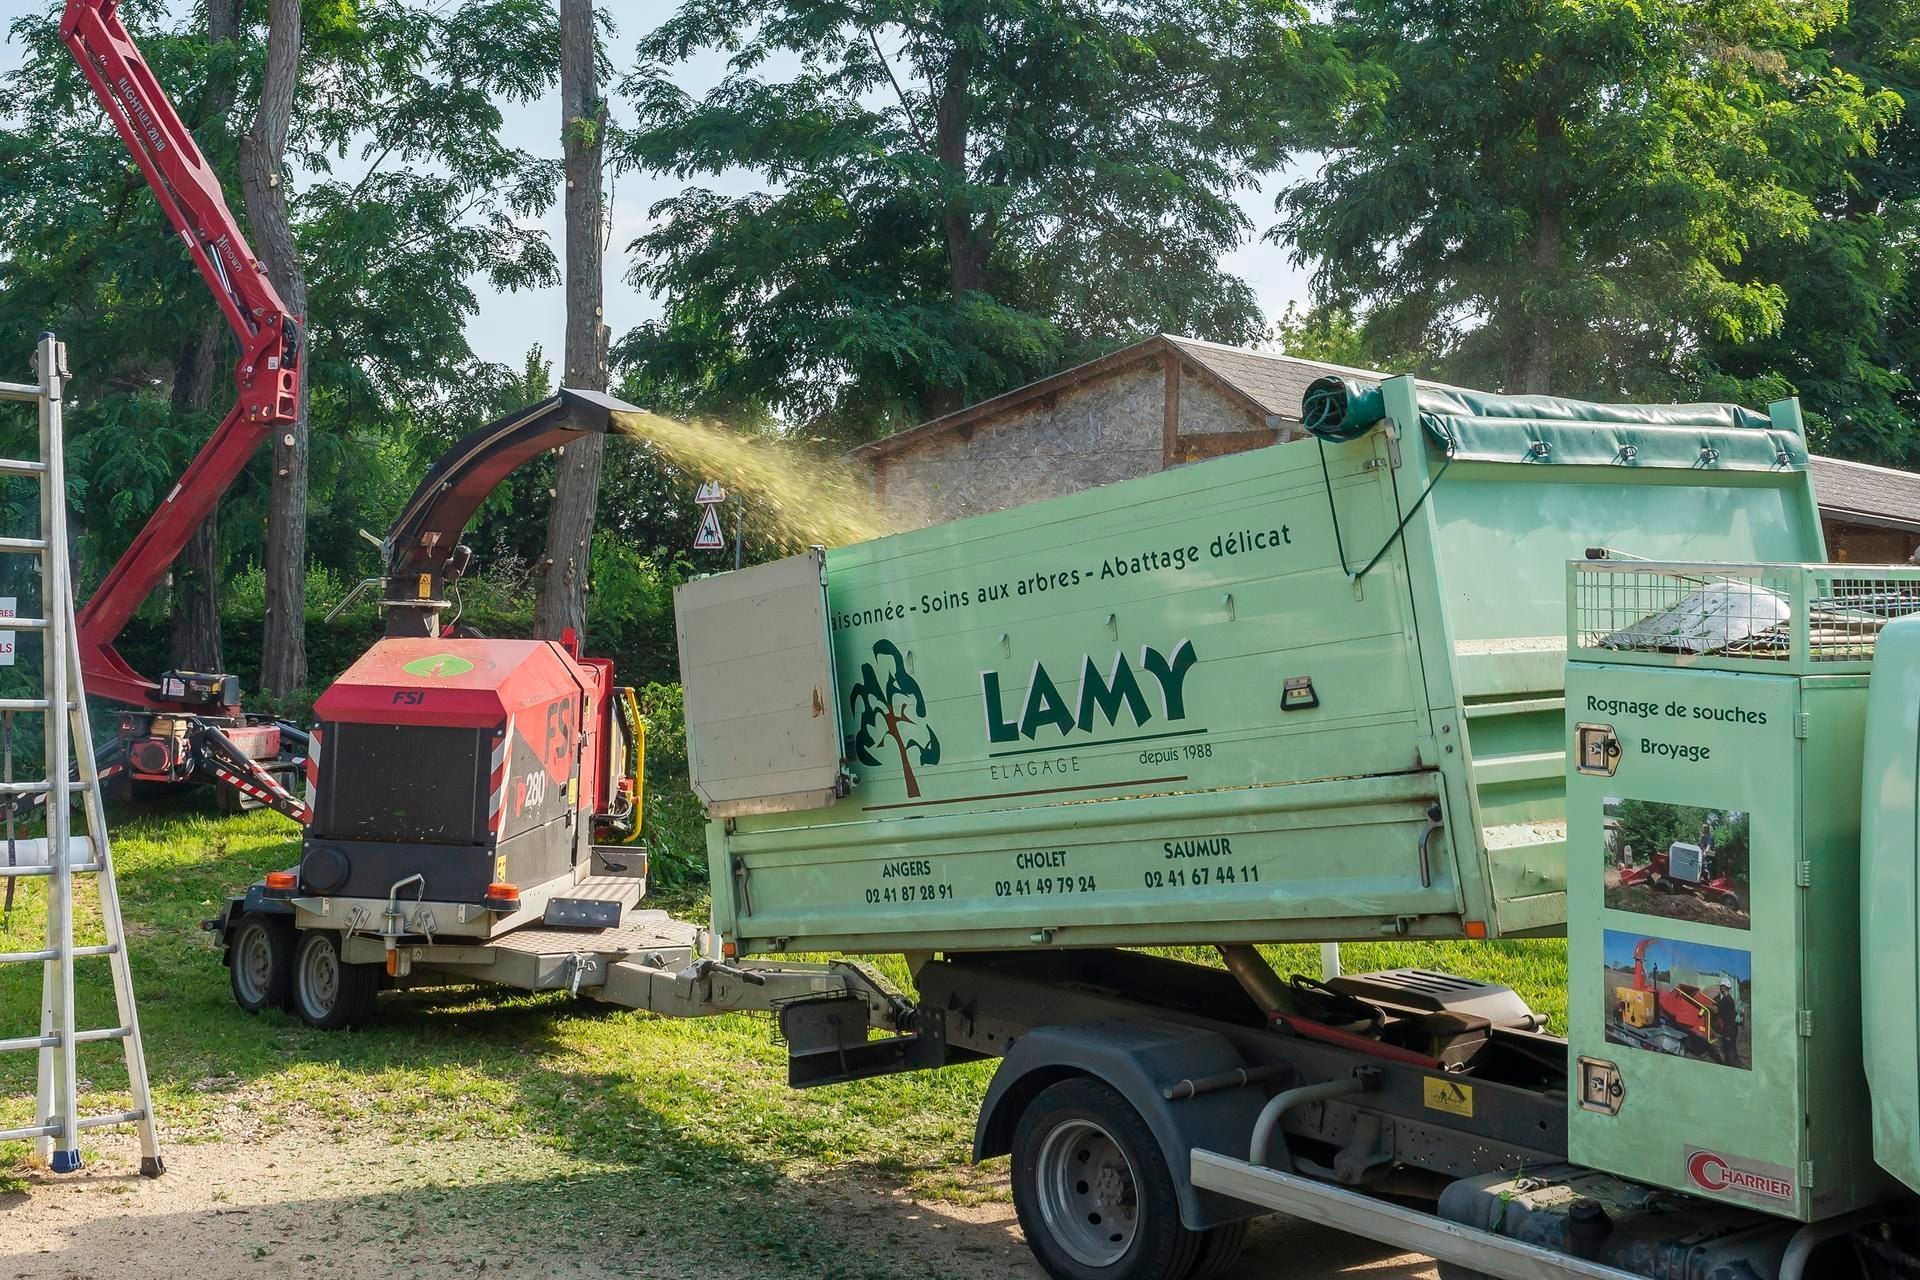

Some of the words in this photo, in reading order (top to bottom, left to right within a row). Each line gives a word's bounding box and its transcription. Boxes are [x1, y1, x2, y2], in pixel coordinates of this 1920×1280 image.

[921, 590, 970, 614] Soins
[977, 584, 1010, 603] aux
[1017, 569, 1080, 598] arbres
[1100, 545, 1200, 580] Abattage
[1209, 524, 1292, 558] délicat
[391, 691, 425, 705] FSI
[979, 638, 1198, 743] LAMY
[1587, 695, 1659, 719] Rognage
[1664, 701, 1687, 718] de
[1693, 706, 1768, 725] souches
[544, 697, 577, 765] FSI
[1139, 749, 1179, 766] depuis
[1182, 743, 1213, 761] 1988
[1640, 738, 1711, 762] Broyage
[990, 756, 1081, 780] ELAGAGE
[524, 769, 546, 808] 280
[1016, 850, 1067, 870] CHOLET
[1163, 838, 1232, 860] SAUMUR
[882, 860, 932, 878] ANGERS
[1687, 1150, 1792, 1197] CHARRIER
